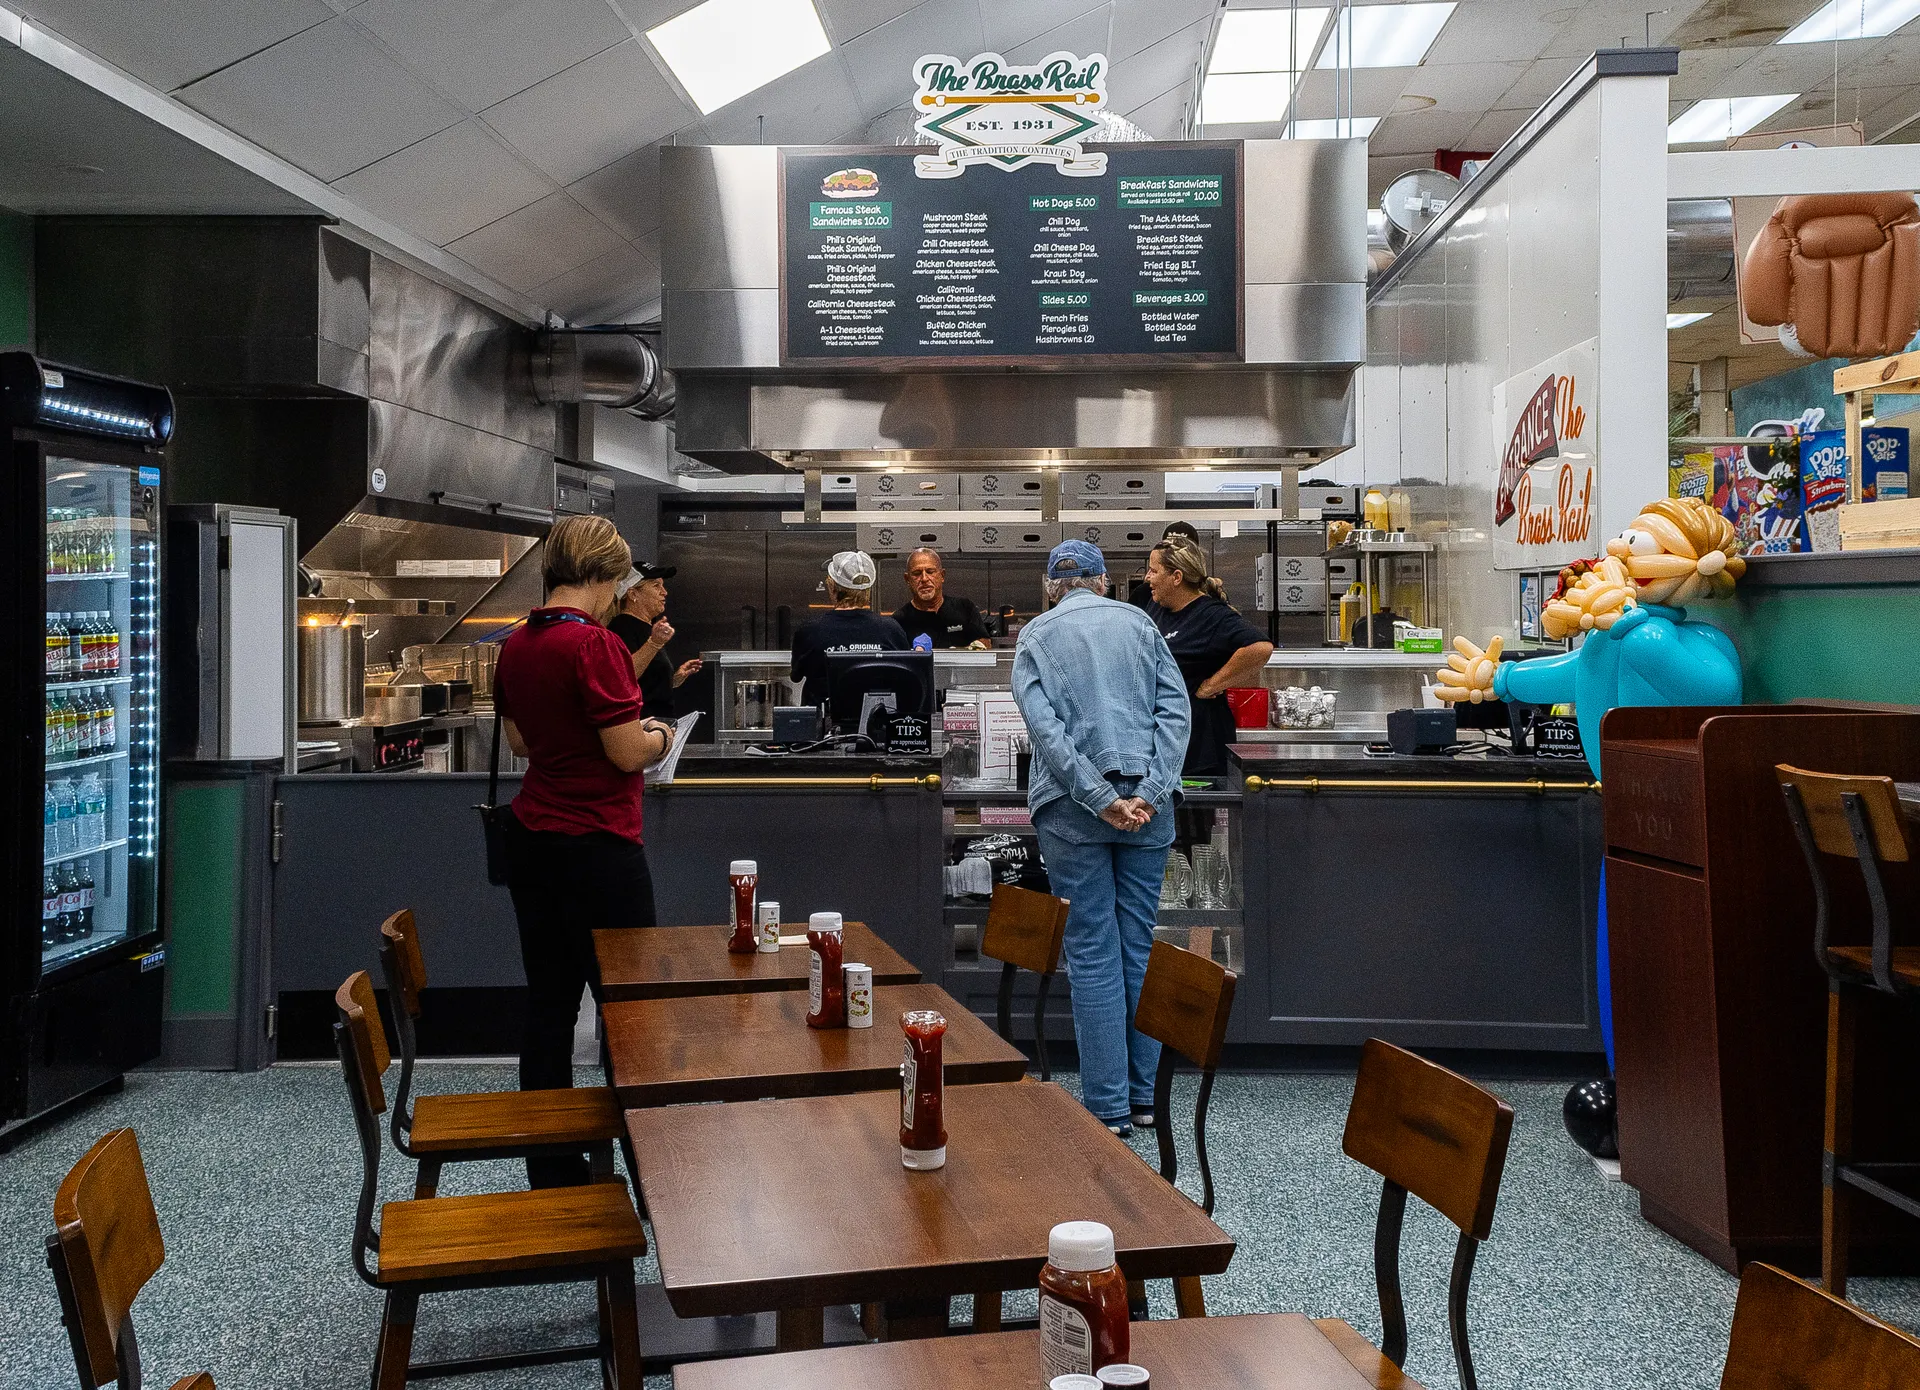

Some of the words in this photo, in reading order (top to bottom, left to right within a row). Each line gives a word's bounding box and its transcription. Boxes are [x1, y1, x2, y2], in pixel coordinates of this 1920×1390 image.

[921, 62, 968, 91] The
[972, 61, 1044, 90] Brass
[1043, 60, 1100, 92] Rail
[966, 121, 1004, 131] EST.
[1013, 120, 1054, 130] 1931
[951, 150, 969, 159] THE
[972, 146, 1019, 156] TRADITION
[1021, 146, 1072, 158] CONTINUES
[1120, 180, 1167, 190] Breakfast
[1168, 179, 1219, 189] Sandwiches
[1194, 191, 1219, 201] 10.00
[1033, 199, 1050, 208] Hot
[1051, 198, 1074, 209] Dogs
[1075, 198, 1096, 207] 5.00
[820, 205, 854, 215] Famous
[855, 205, 881, 214] Steak
[812, 217, 863, 226] Sandwiches
[864, 216, 889, 226] 10.00
[923, 213, 963, 222] Mushroom
[964, 213, 988, 221] Steak
[1048, 217, 1064, 226] Chili
[1065, 217, 1081, 227] Dog
[1140, 215, 1154, 223] The
[1155, 214, 1170, 223] Ack
[1171, 214, 1200, 223] Attack
[826, 235, 845, 244] Phil's
[846, 235, 876, 245] Original
[922, 239, 938, 248] Chili
[939, 239, 989, 248] Cheesesteak
[1137, 235, 1178, 244] Breakfast
[1179, 235, 1203, 243] Steak
[821, 244, 845, 253] Steak
[845, 244, 882, 253] Sandwich
[1033, 243, 1049, 252] Chili
[1050, 243, 1078, 252] Cheese
[1079, 243, 1095, 253] Dog
[916, 259, 945, 269] Chicken
[946, 259, 996, 268] Cheesesteak
[1144, 261, 1164, 270] Fried
[1165, 261, 1180, 271] Egg
[1181, 260, 1197, 269] BLT
[827, 265, 846, 273] Phil's
[846, 264, 876, 275] Original
[1044, 269, 1067, 278] Kraut
[1070, 269, 1085, 279] Dog
[827, 274, 877, 283] Cheesesteak
[937, 285, 975, 294] California
[916, 295, 945, 303] Chicken
[946, 294, 996, 303] Cheesesteak
[1042, 295, 1065, 305] Sides
[1067, 295, 1088, 304] 5.00
[1136, 294, 1182, 305] Beverages
[1184, 293, 1205, 303] 3.00
[807, 300, 845, 309] California
[846, 299, 896, 308] Cheesesteak
[1041, 314, 1068, 323] French
[1069, 314, 1089, 322] Fries
[1141, 313, 1172, 321] Bottled
[820, 326, 834, 334] A-1
[834, 325, 884, 334] Cheesesteak
[926, 321, 956, 330] Buffalo
[957, 321, 987, 329] Chicken
[1041, 324, 1077, 335] Pierogies
[1078, 324, 1089, 333] (3)
[1144, 323, 1175, 332] Bottled
[1176, 323, 1196, 331] Soda
[931, 330, 981, 339] Cheesesteak
[1036, 335, 1083, 344] Hashbrowns
[1084, 335, 1095, 343] (2)
[1154, 334, 1170, 342] Iced
[1172, 334, 1187, 342] Tea
[1556, 375, 1586, 440] The
[1679, 476, 1708, 492] FROSTED
[1811, 481, 1846, 498] Strawberr
[1517, 472, 1556, 545] Brass
[1557, 463, 1592, 543] Rail
[896, 725, 922, 736] TIPS
[1545, 729, 1574, 740] TIPS
[900, 739, 927, 748] appreciated
[1620, 776, 1682, 804] THANK
[1630, 811, 1672, 840] YOU
